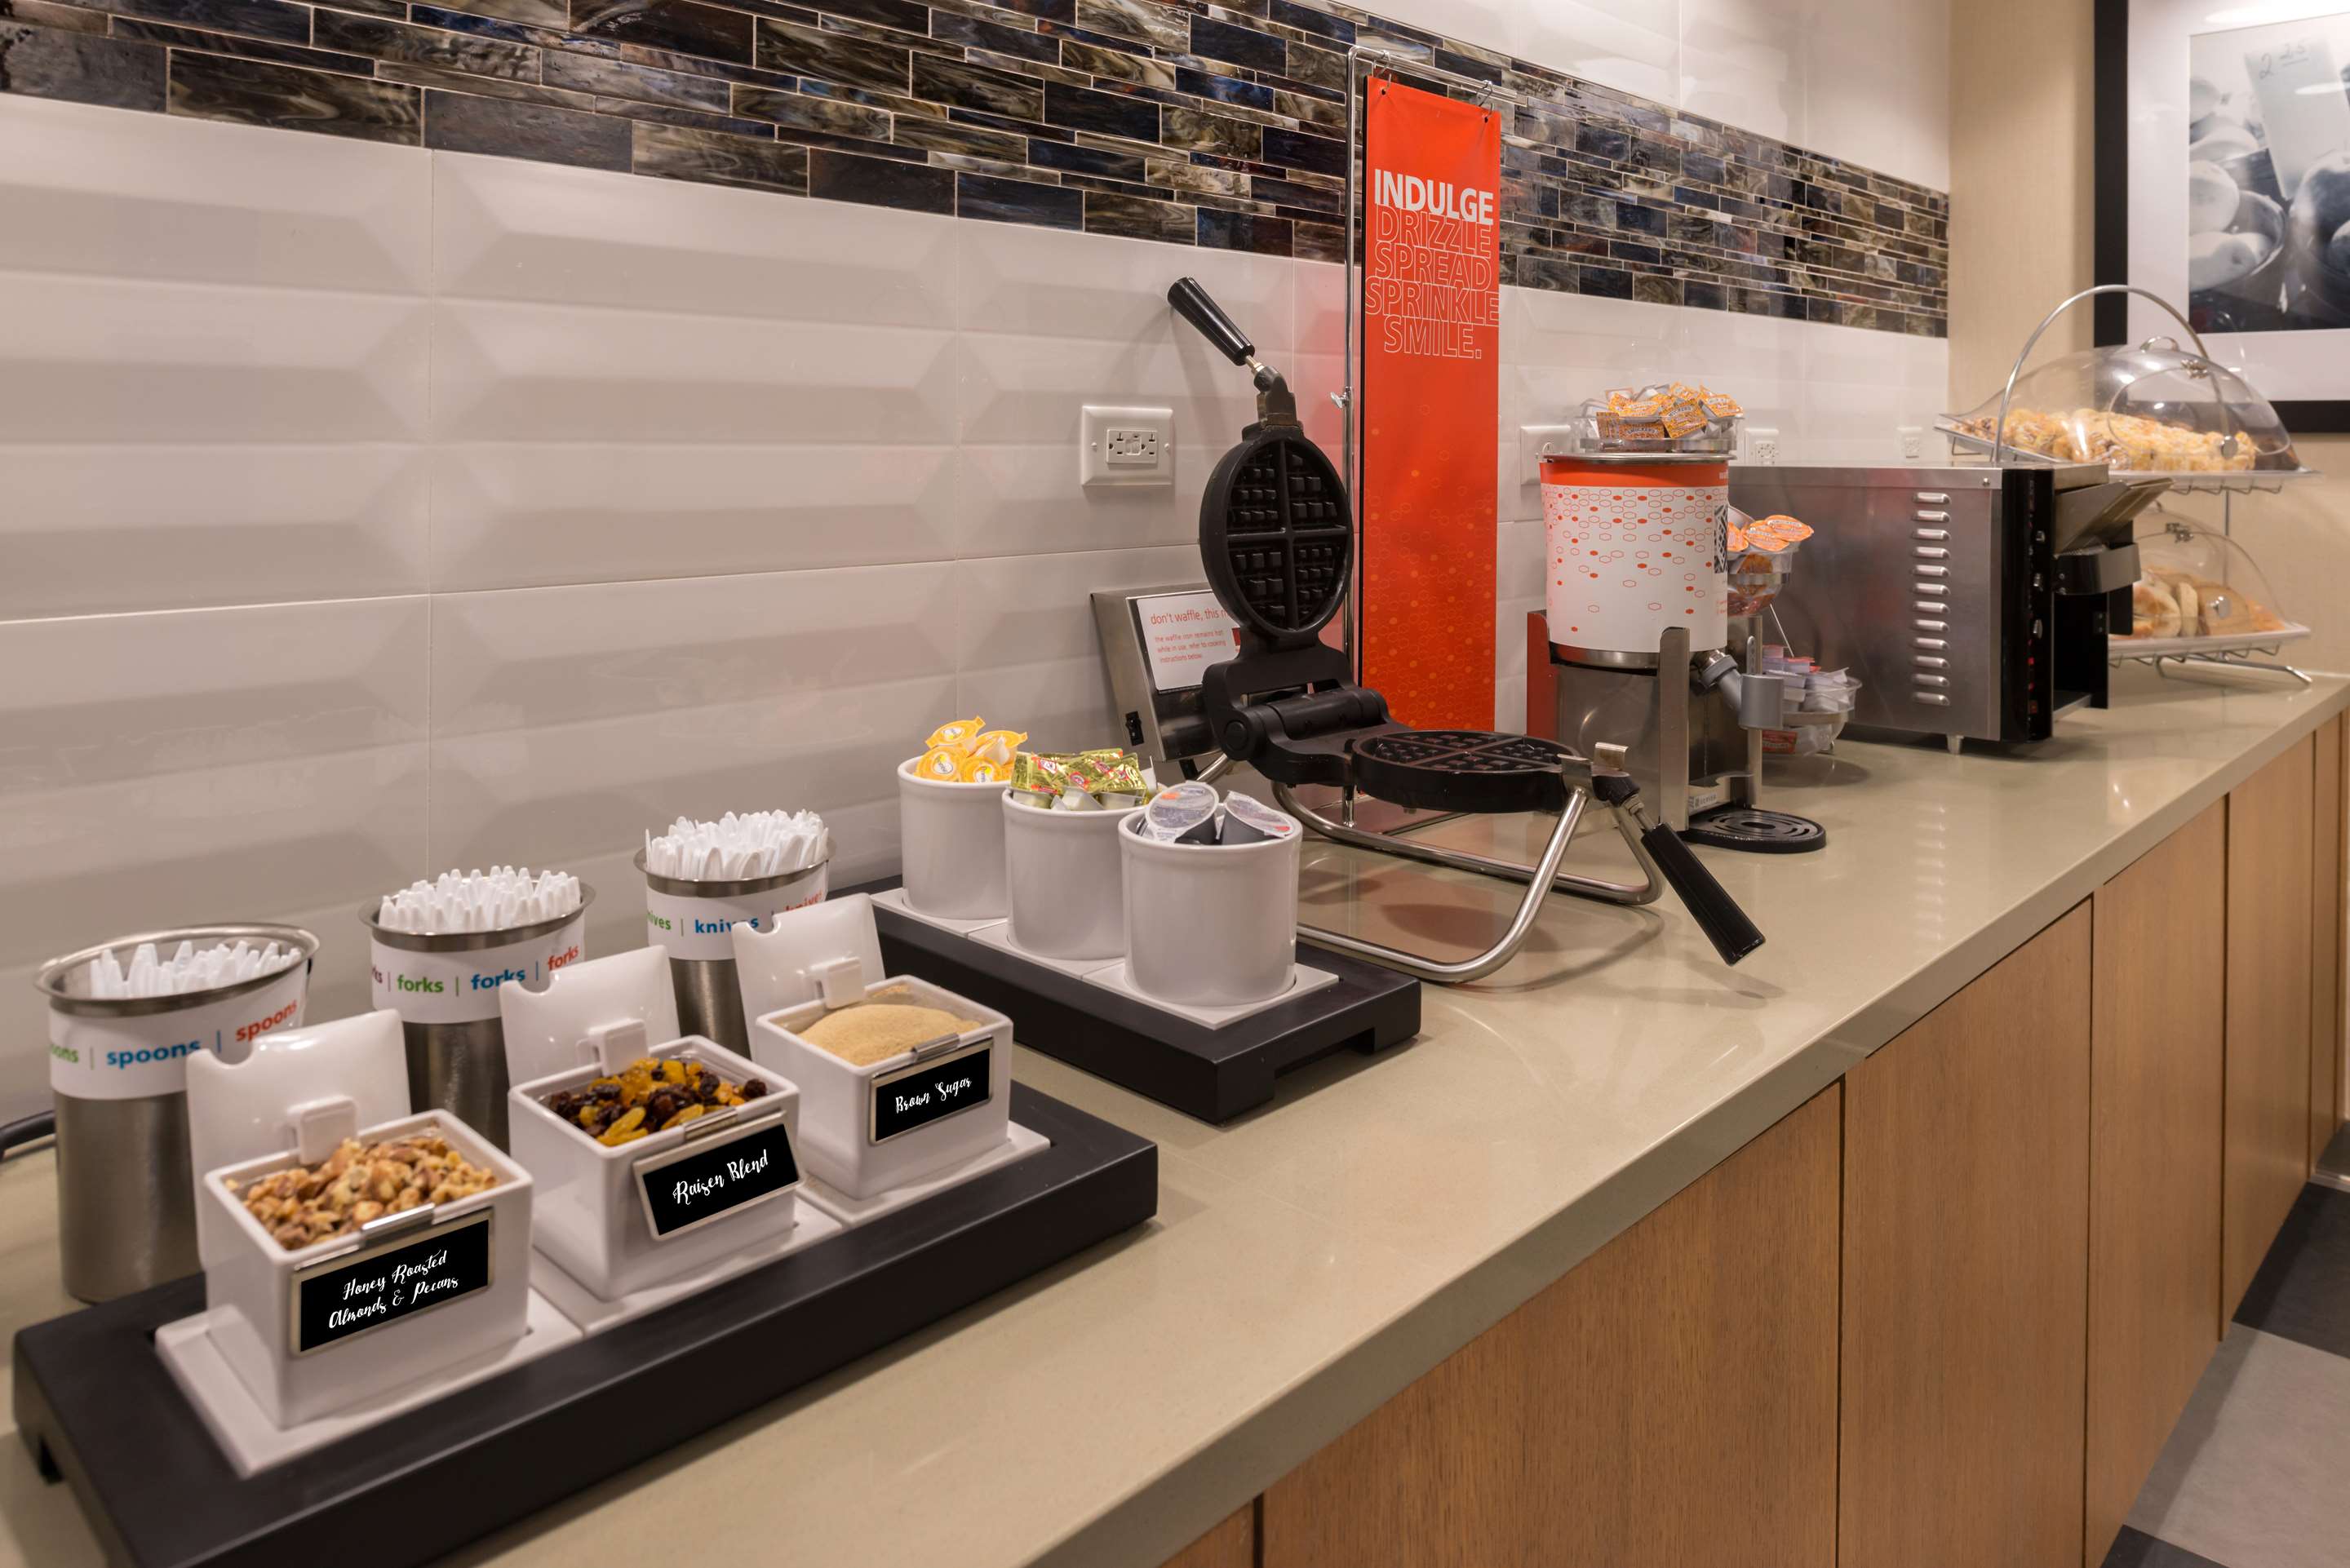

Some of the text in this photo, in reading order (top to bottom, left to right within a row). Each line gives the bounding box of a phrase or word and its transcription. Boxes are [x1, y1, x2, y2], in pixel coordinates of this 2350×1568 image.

[1375, 169, 1493, 225] INDULGE
[1377, 204, 1492, 259] DRIZZLE
[1375, 241, 1492, 291] SPREAD
[1365, 276, 1500, 326] SPRINKLE
[1384, 314, 1482, 359] SMILE.
[1151, 613, 1173, 625] don't
[1175, 609, 1204, 622] waffle,
[1205, 608, 1219, 619] this
[397, 975, 444, 994] forks
[471, 969, 525, 990] forks
[548, 946, 579, 971] forks
[107, 1039, 201, 1070] spoons
[236, 1000, 297, 1043] spoons
[895, 1078, 972, 1114] Brown Sugar
[672, 1149, 769, 1206] Raisen Blend
[343, 1249, 447, 1300] Honey Roasted
[329, 1278, 459, 1329] Almonds & Pecans
